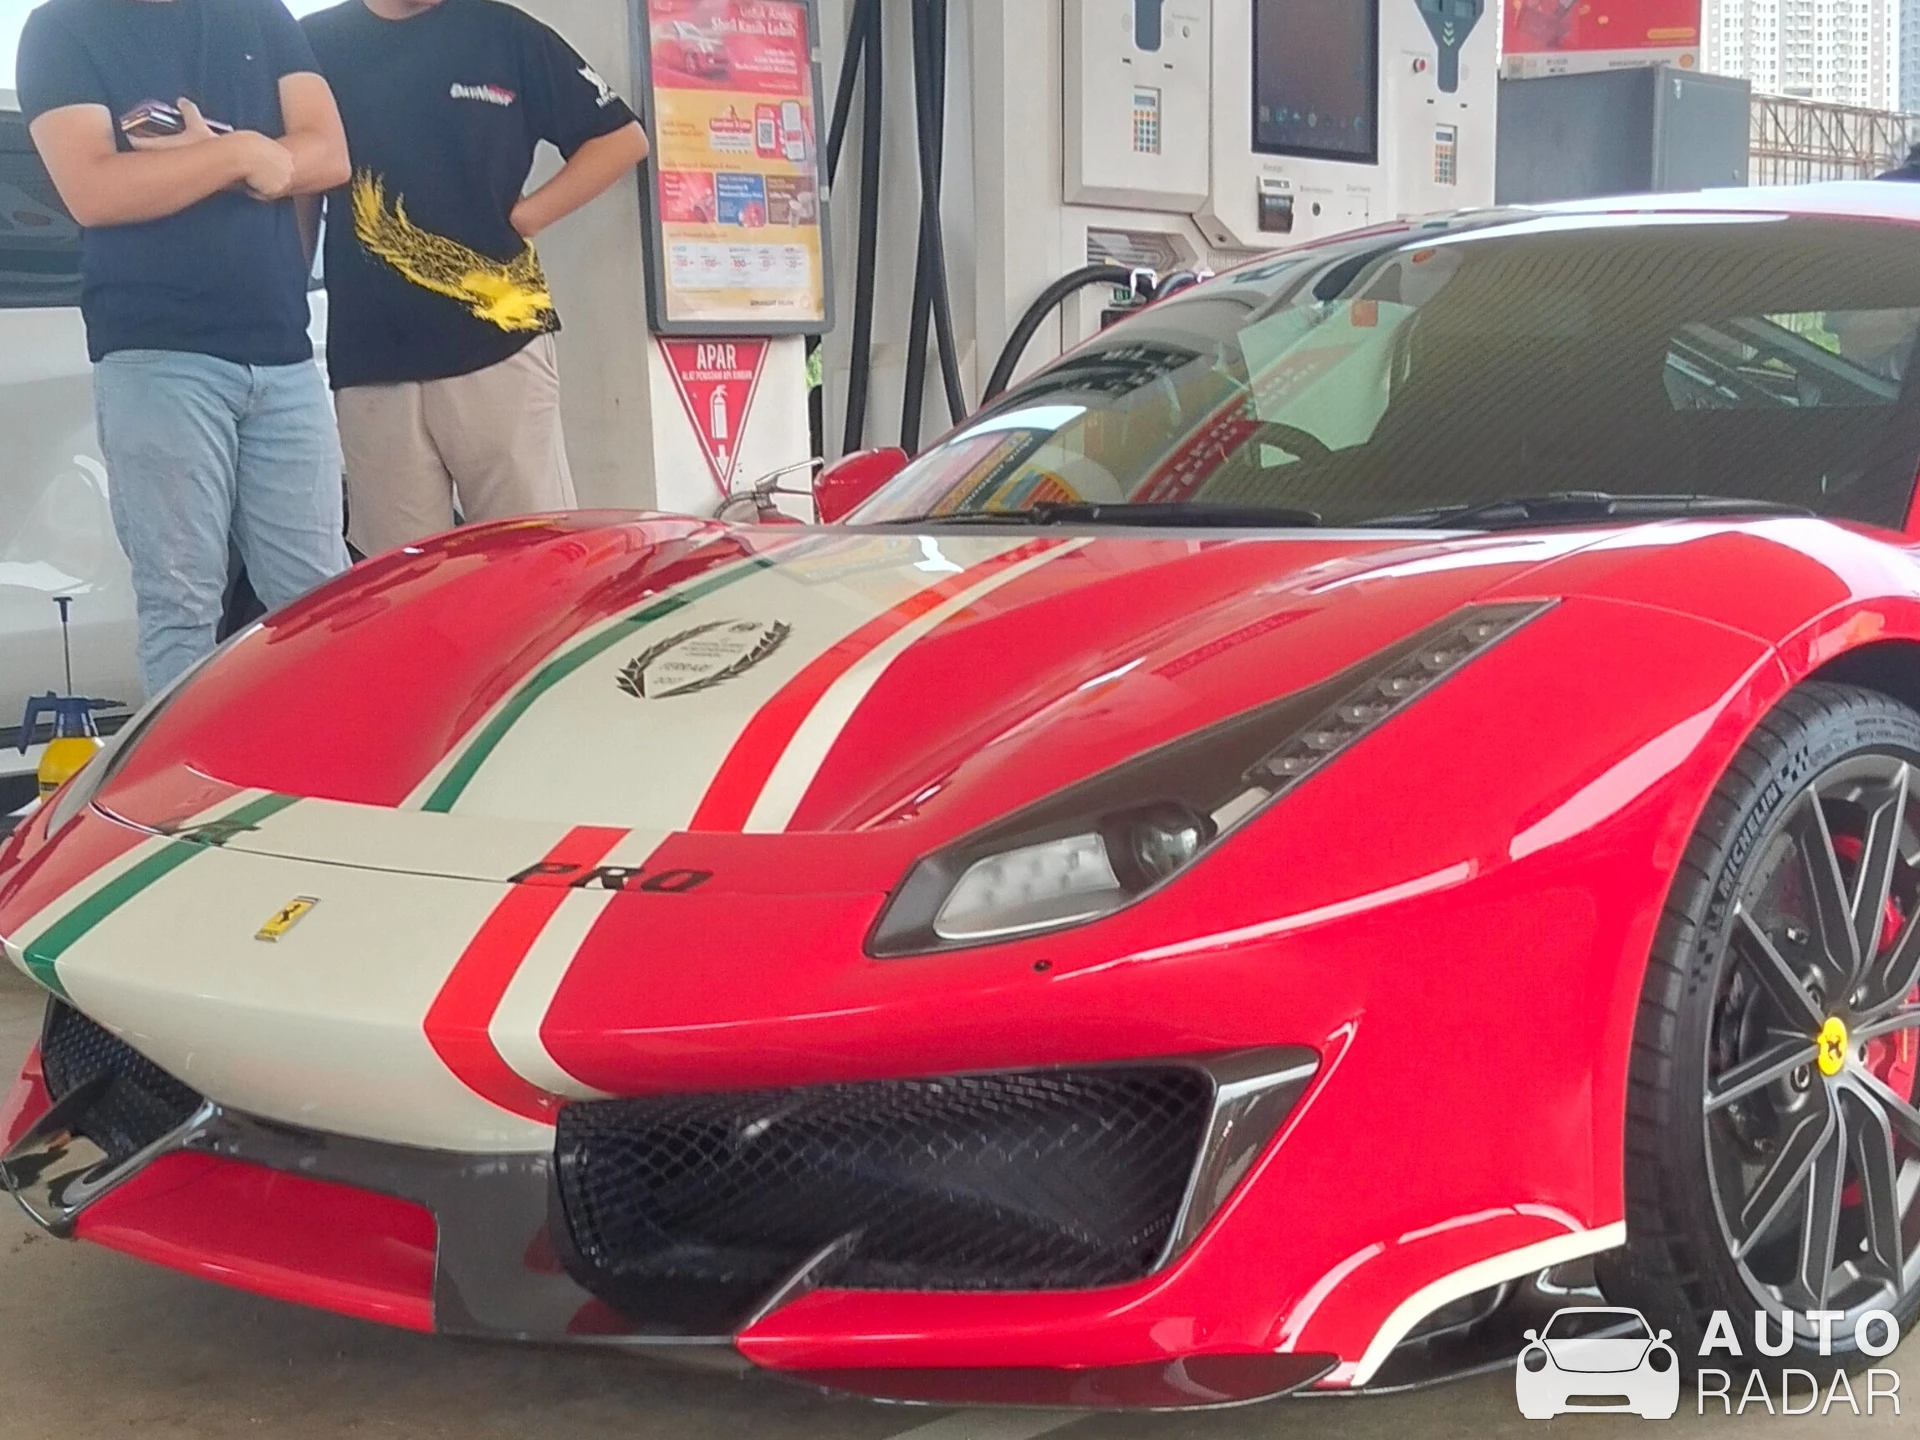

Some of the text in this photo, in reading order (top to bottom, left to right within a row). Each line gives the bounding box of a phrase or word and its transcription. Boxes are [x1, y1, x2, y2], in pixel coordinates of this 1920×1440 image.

[696, 343, 737, 371] APAR
[1717, 781, 1783, 900] MICHELIN
[506, 861, 714, 893] PRO
